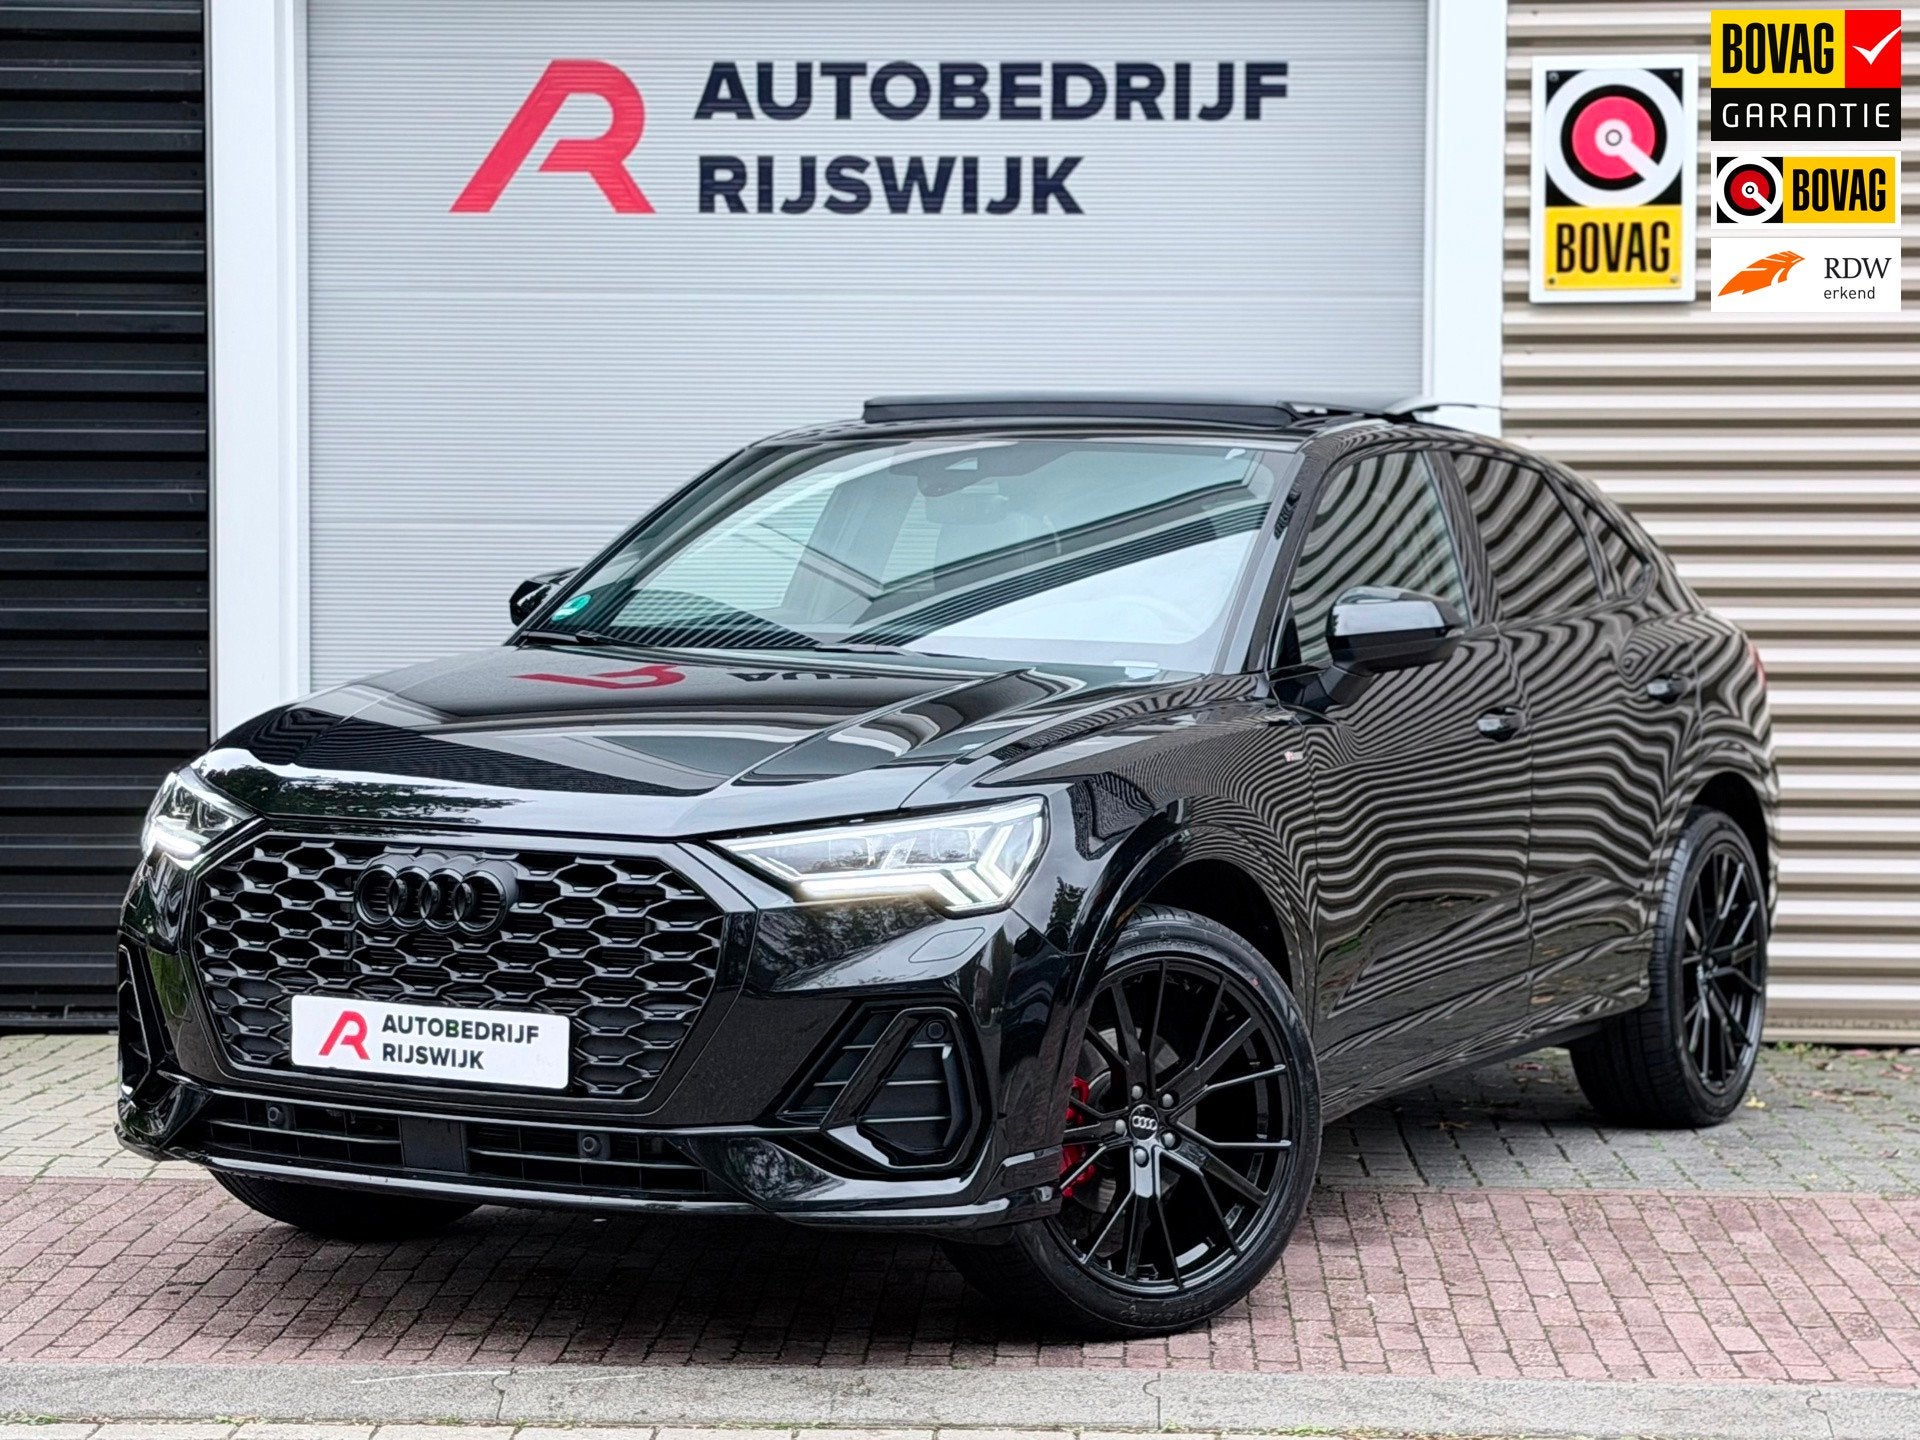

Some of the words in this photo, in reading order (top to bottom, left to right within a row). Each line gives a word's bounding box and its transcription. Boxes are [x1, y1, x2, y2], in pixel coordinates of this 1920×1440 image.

[693, 61, 1289, 121] AUTOBEDRIJF
[698, 155, 1084, 215] RIJSWIJK
[1556, 221, 1670, 273] BOVAG
[382, 1014, 539, 1044] AUTOBEDRIJF
[382, 1043, 484, 1070] RIJSWIJK
